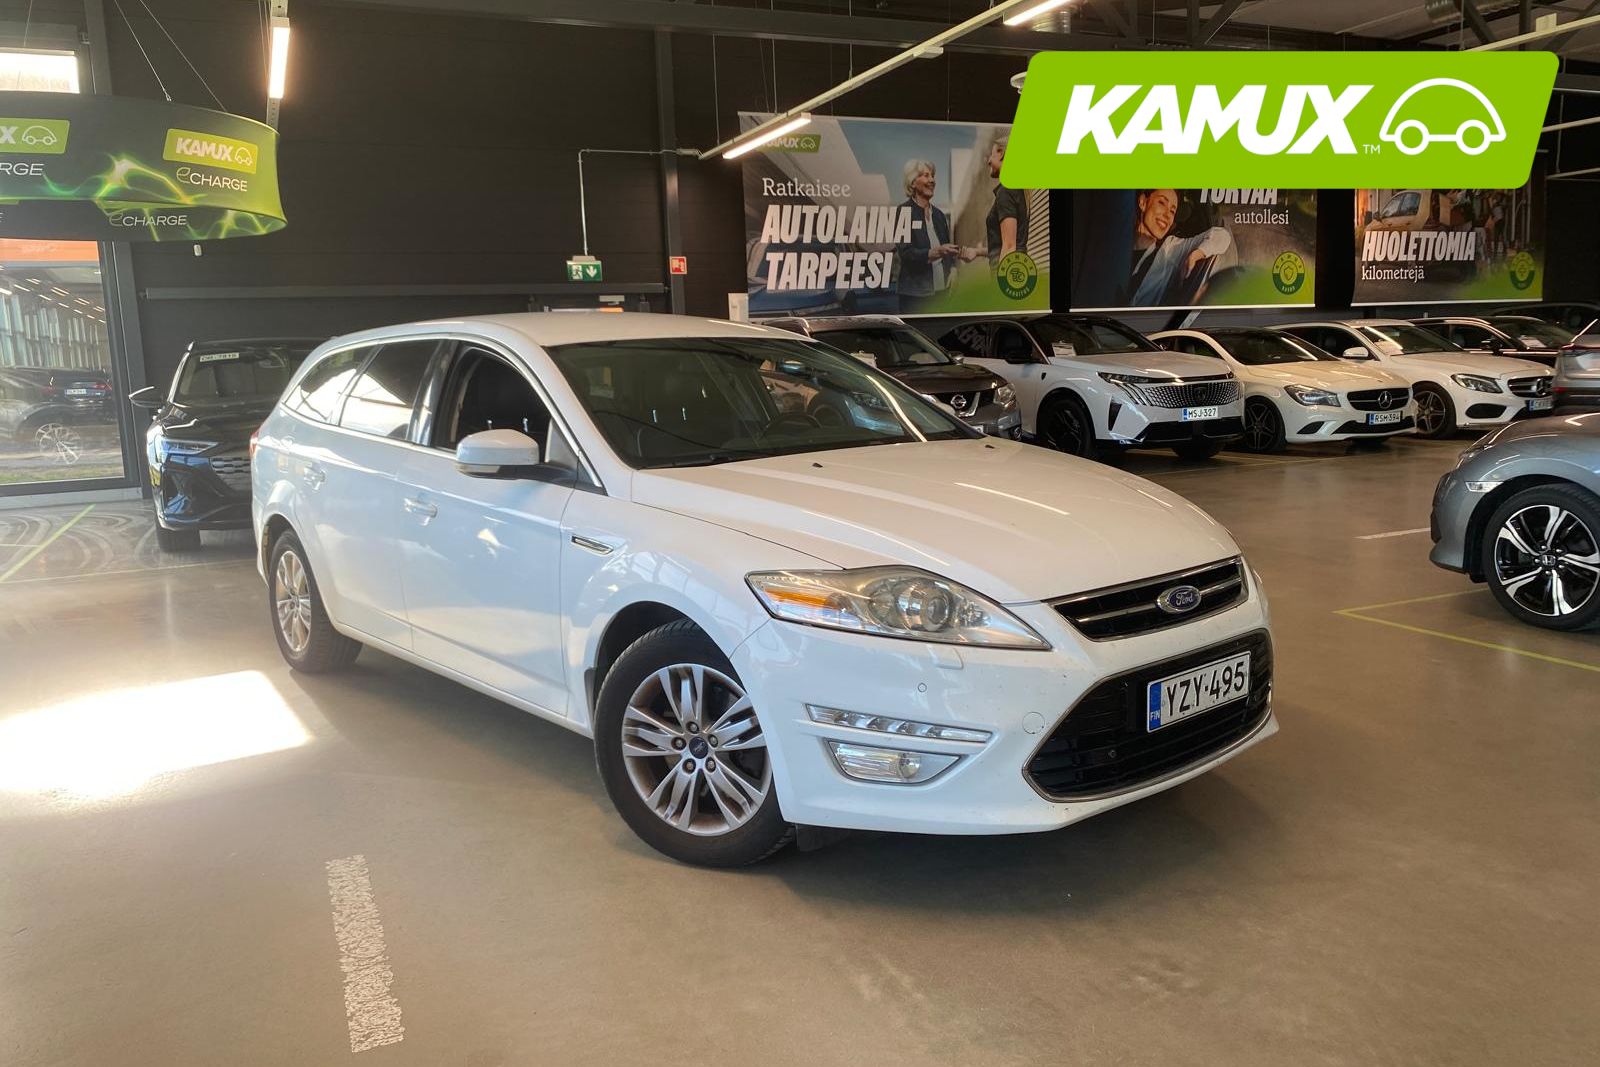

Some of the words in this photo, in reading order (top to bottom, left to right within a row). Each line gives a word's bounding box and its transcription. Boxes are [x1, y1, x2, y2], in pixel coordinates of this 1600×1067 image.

[176, 137, 234, 162] KAMUX
[761, 177, 851, 198] Ratkaisee
[760, 204, 923, 244] AUTOLAINA-
[1233, 209, 1290, 225] autollesi
[1361, 230, 1477, 262] HUOLETTOMIA
[765, 252, 894, 291] TARPEESI
[1361, 265, 1425, 283] kilometrejä
[1176, 592, 1193, 606] Ford
[1167, 661, 1244, 717] YZY-495
[1150, 709, 1161, 721] FIN
